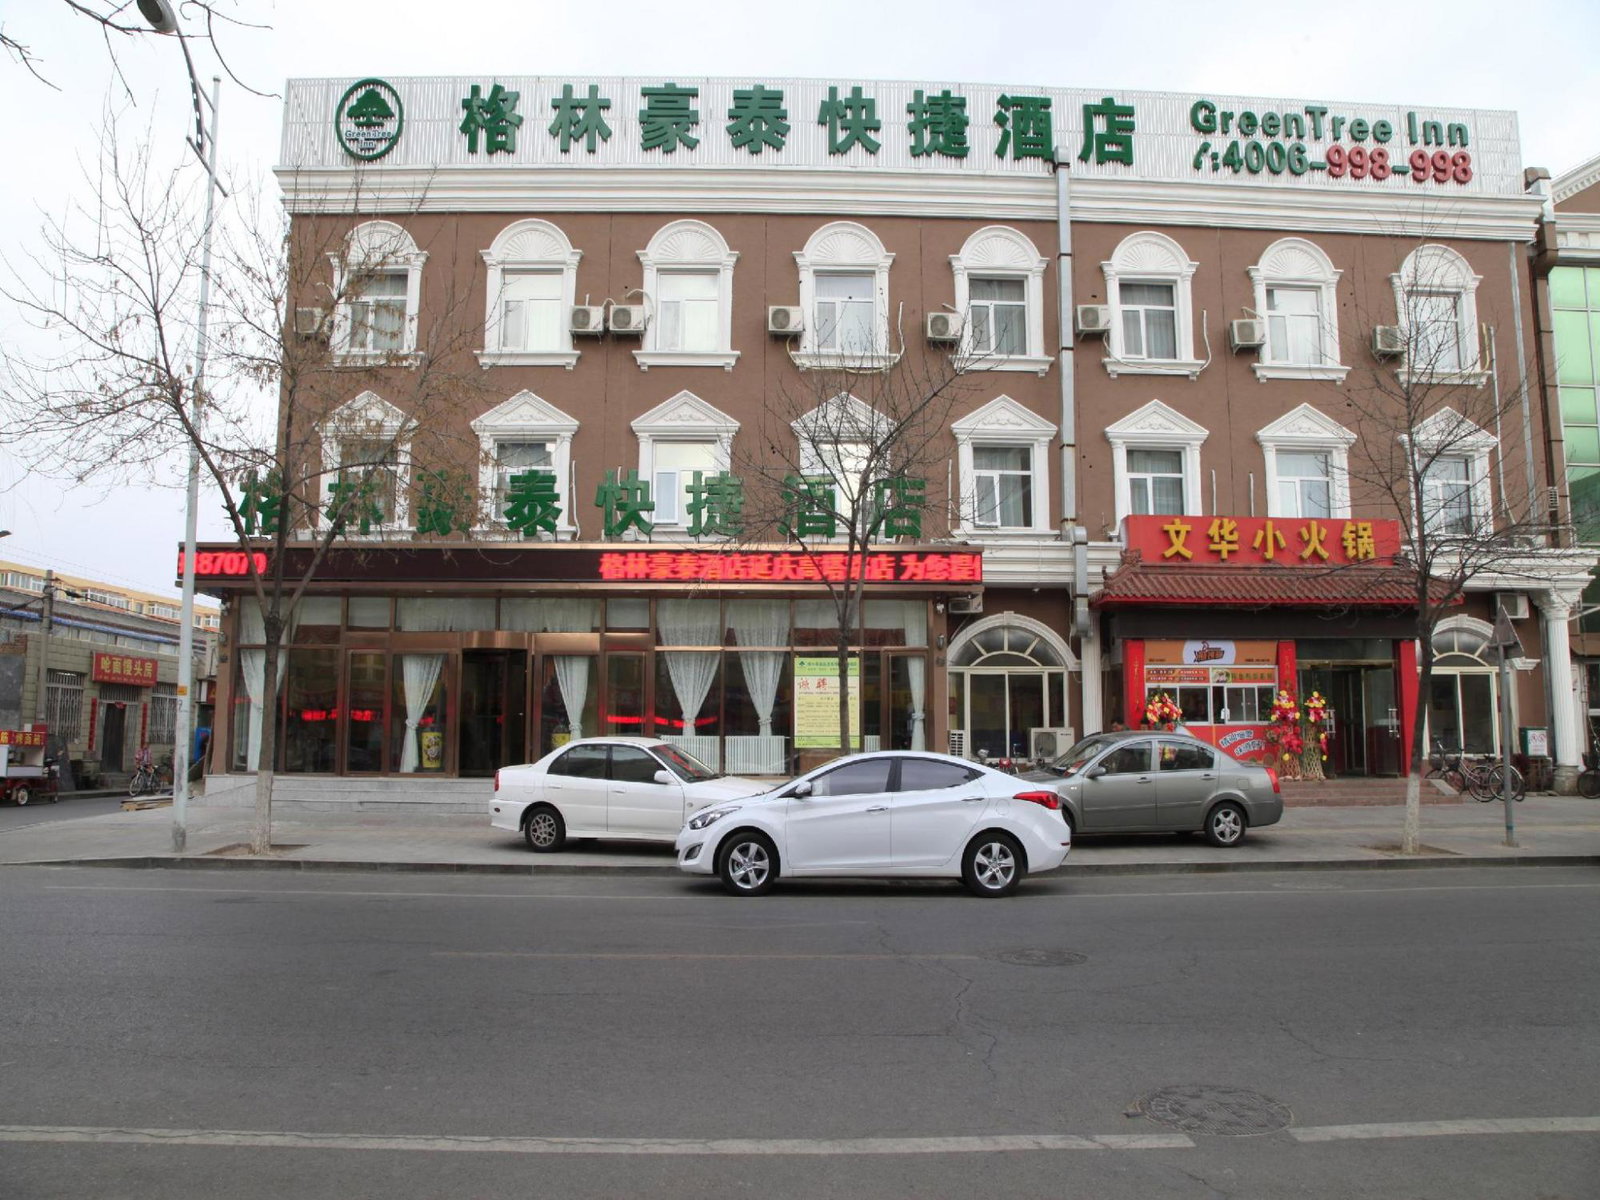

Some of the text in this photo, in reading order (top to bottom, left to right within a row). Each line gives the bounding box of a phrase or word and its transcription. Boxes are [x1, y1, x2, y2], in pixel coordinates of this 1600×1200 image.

[459, 83, 1136, 166] 格林豪泰快捷酒店
[1190, 100, 1469, 147] GreenTree Inn
[1162, 517, 1376, 561] 文华小火锅
